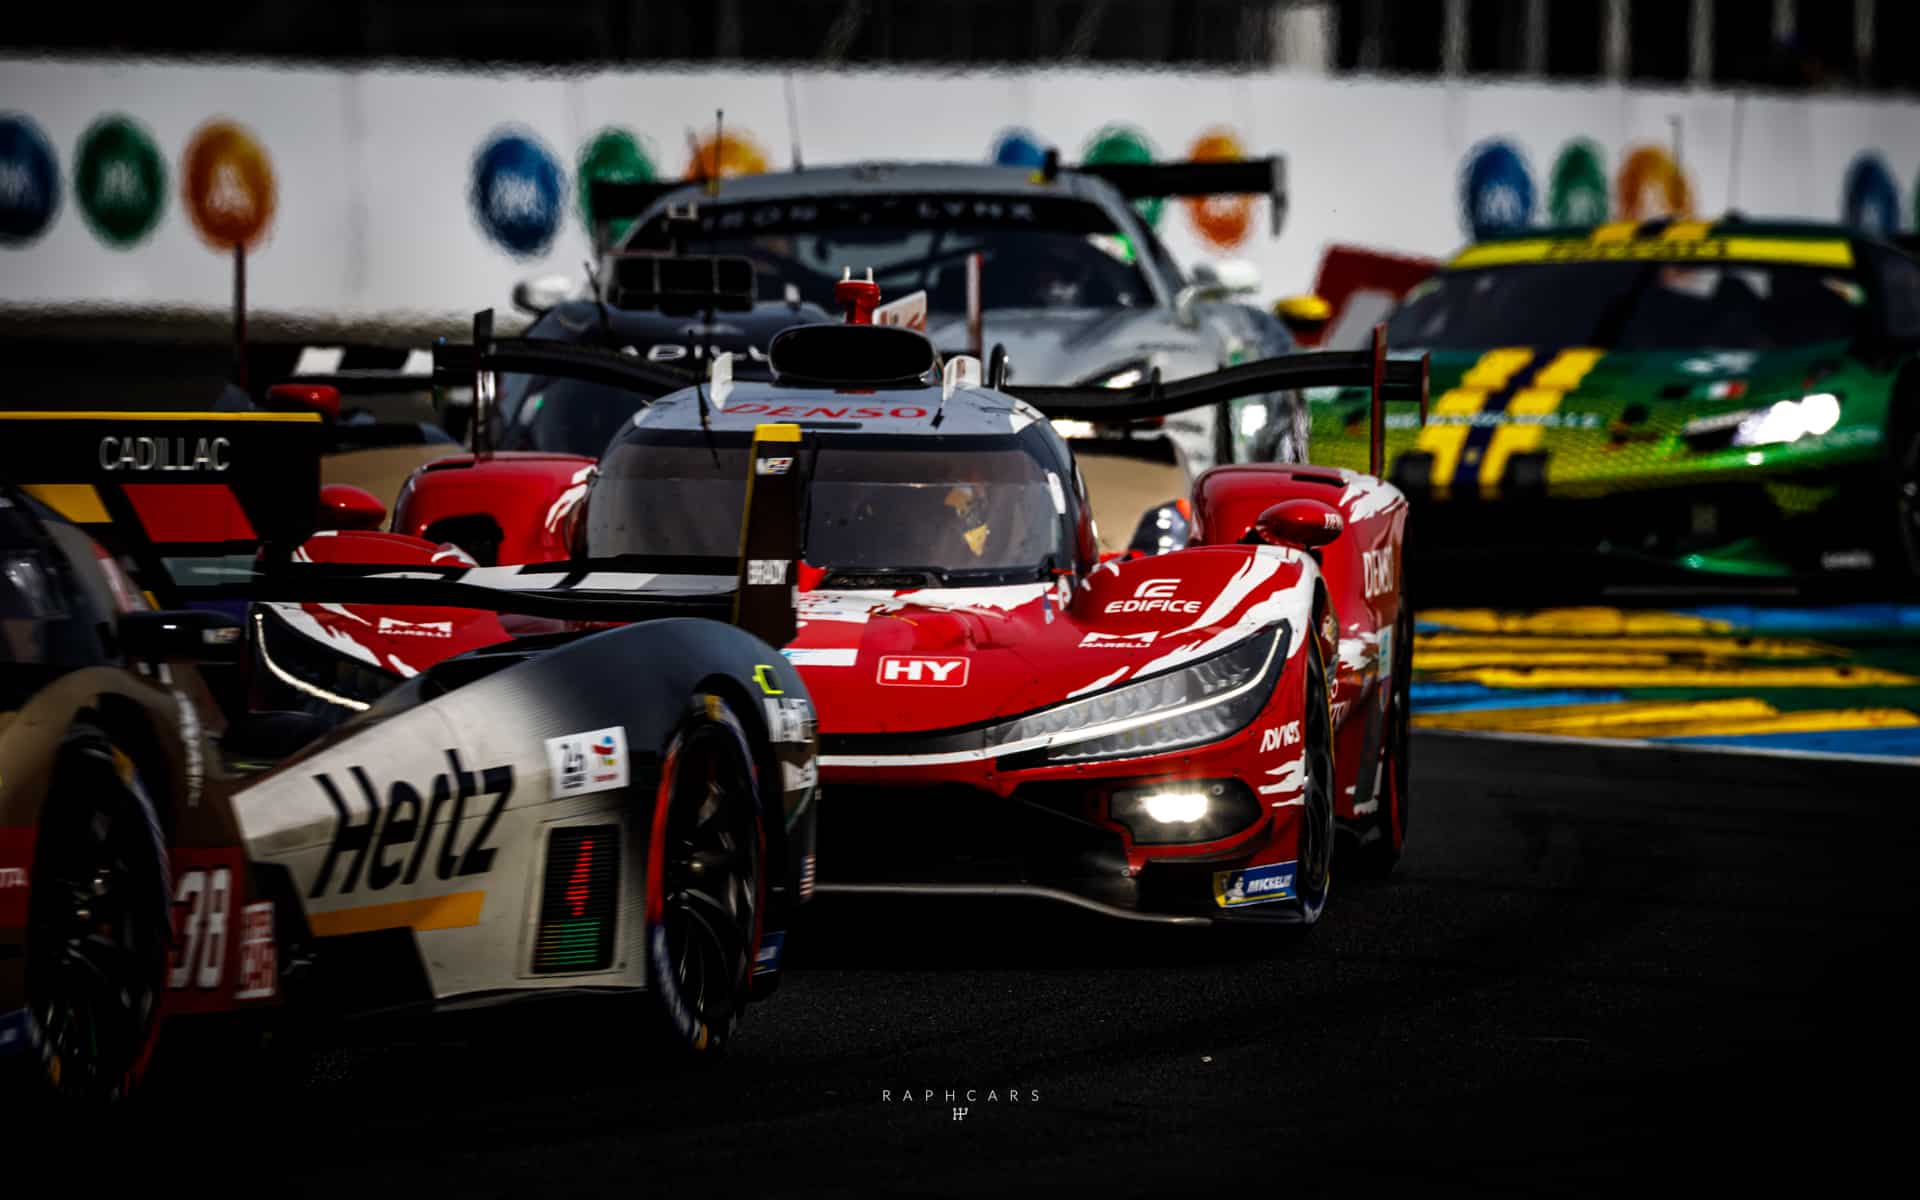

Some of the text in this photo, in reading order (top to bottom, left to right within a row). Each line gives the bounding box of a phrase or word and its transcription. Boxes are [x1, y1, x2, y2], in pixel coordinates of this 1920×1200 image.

[917, 198, 1034, 224] LYNX
[721, 403, 928, 419] DENSO
[99, 436, 231, 471] CADILLAC
[1104, 600, 1202, 613] EDIFICE
[884, 660, 962, 681] HY
[308, 748, 516, 899] Hertz
[167, 867, 232, 990] 38
